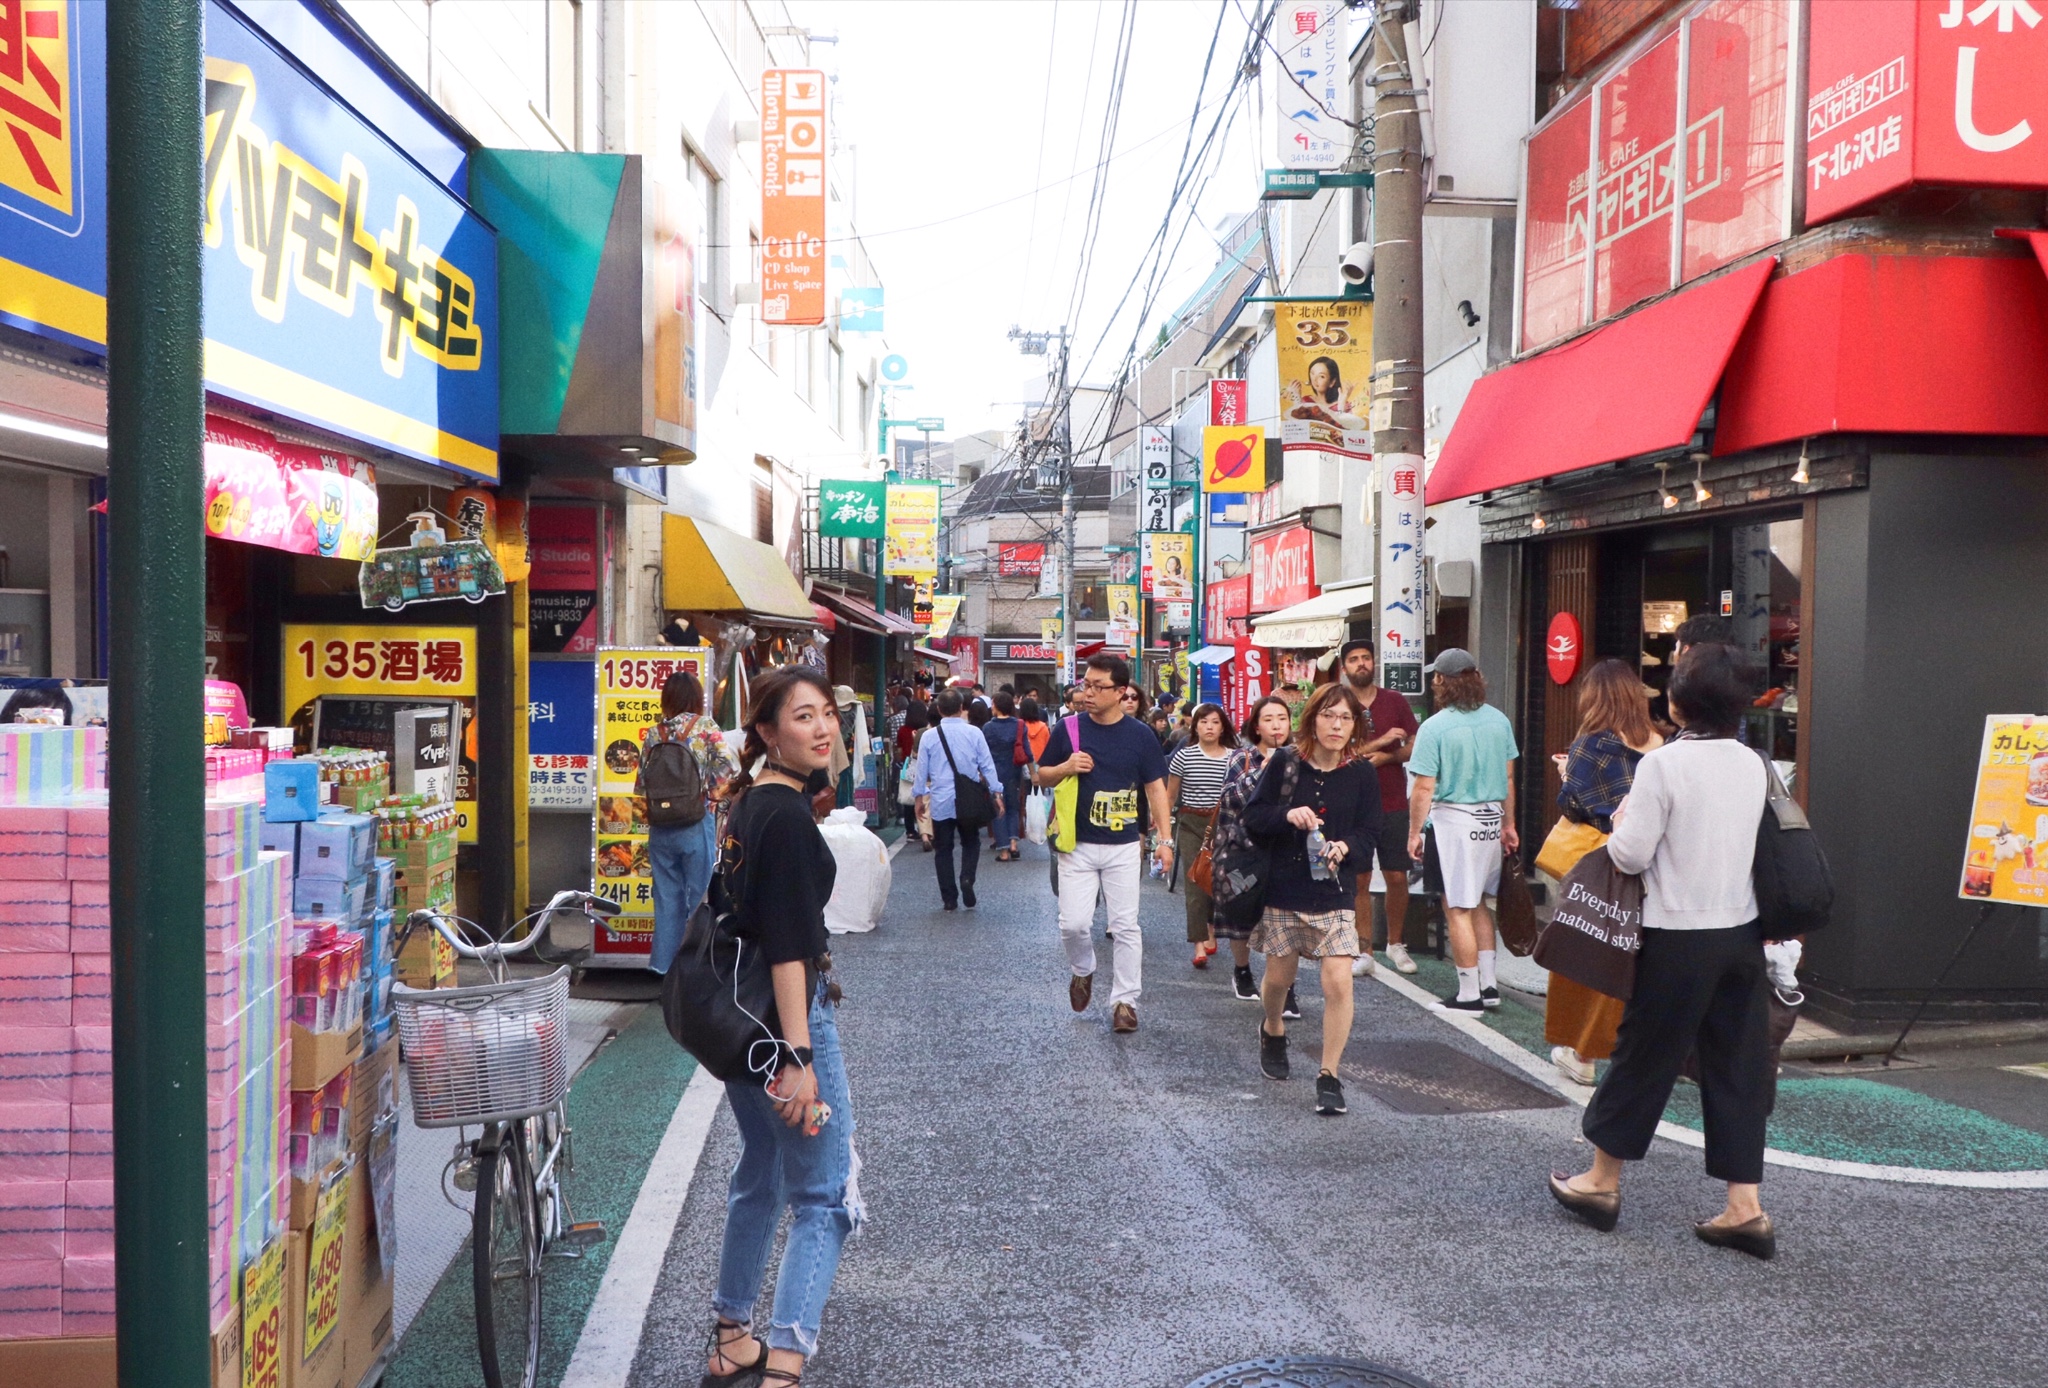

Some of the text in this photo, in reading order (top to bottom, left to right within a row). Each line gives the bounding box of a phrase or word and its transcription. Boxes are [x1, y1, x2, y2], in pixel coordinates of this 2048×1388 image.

[1291, 153, 1334, 162] 3414-4940
[1610, 137, 1639, 169] CAFE
[1807, 115, 1902, 190] 下北沢店
[764, 262, 780, 274] CD
[765, 278, 788, 291] Live
[768, 305, 782, 314] 2F
[825, 490, 865, 502] キッチン
[831, 498, 879, 525] 南海
[540, 550, 590, 562] Studio
[530, 609, 582, 621] 3414-9833
[574, 636, 596, 651] 3F
[1010, 644, 1057, 659] mis
[1383, 651, 1423, 660] 3414-4940
[299, 640, 463, 683] 135酒場
[1390, 670, 1418, 679] 北沢
[1390, 681, 1417, 690] 2-19
[528, 701, 555, 723] 科
[616, 701, 662, 711] 安くて食べ
[533, 755, 588, 768] も診療
[531, 771, 587, 785] 時まで
[600, 883, 654, 904] 24H 年
[1567, 882, 1631, 926] Everyday
[1557, 911, 1609, 943] natural
[316, 1232, 343, 1292] 498
[316, 1282, 338, 1330] 462
[252, 1305, 279, 1381] 189
